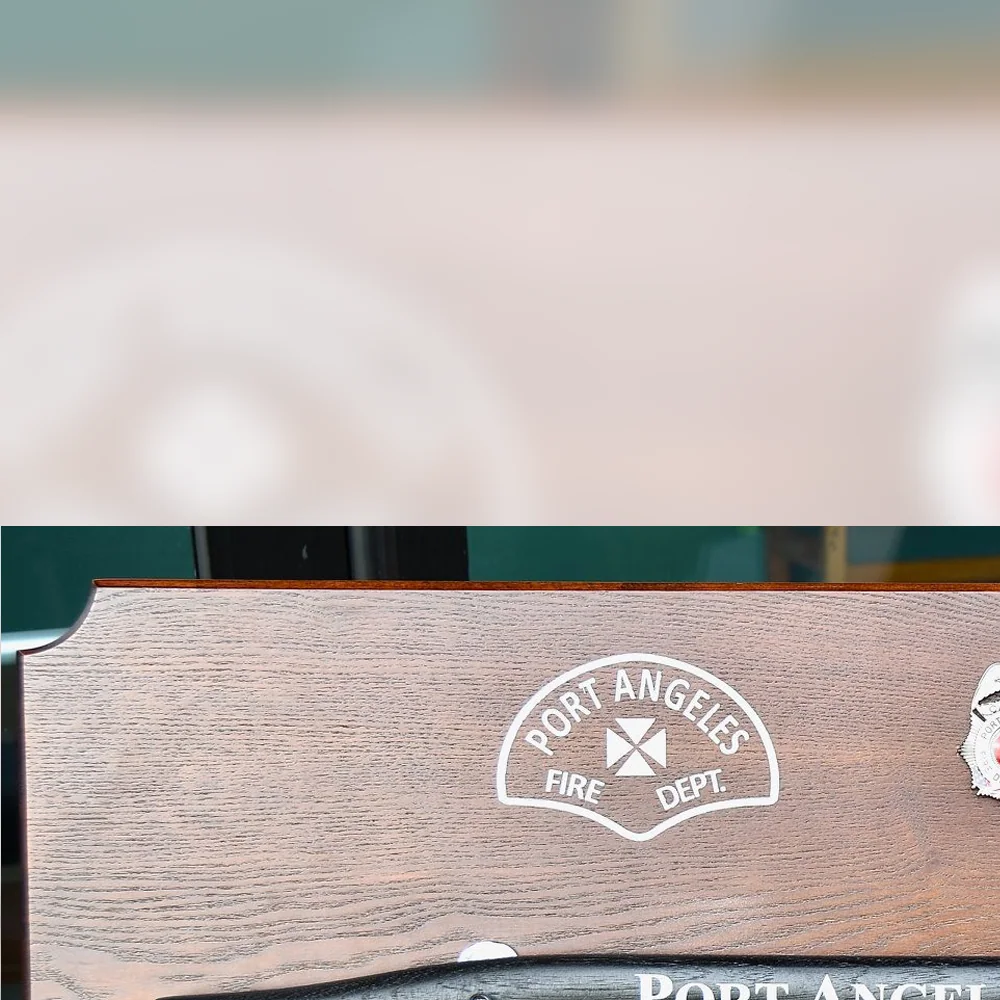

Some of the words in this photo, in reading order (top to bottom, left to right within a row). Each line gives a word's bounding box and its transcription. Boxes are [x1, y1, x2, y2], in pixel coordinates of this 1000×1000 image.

[524, 678, 601, 756] PORT
[615, 669, 750, 755] ANGELES
[545, 769, 605, 804] FIRE
[656, 769, 727, 811] DEPT.
